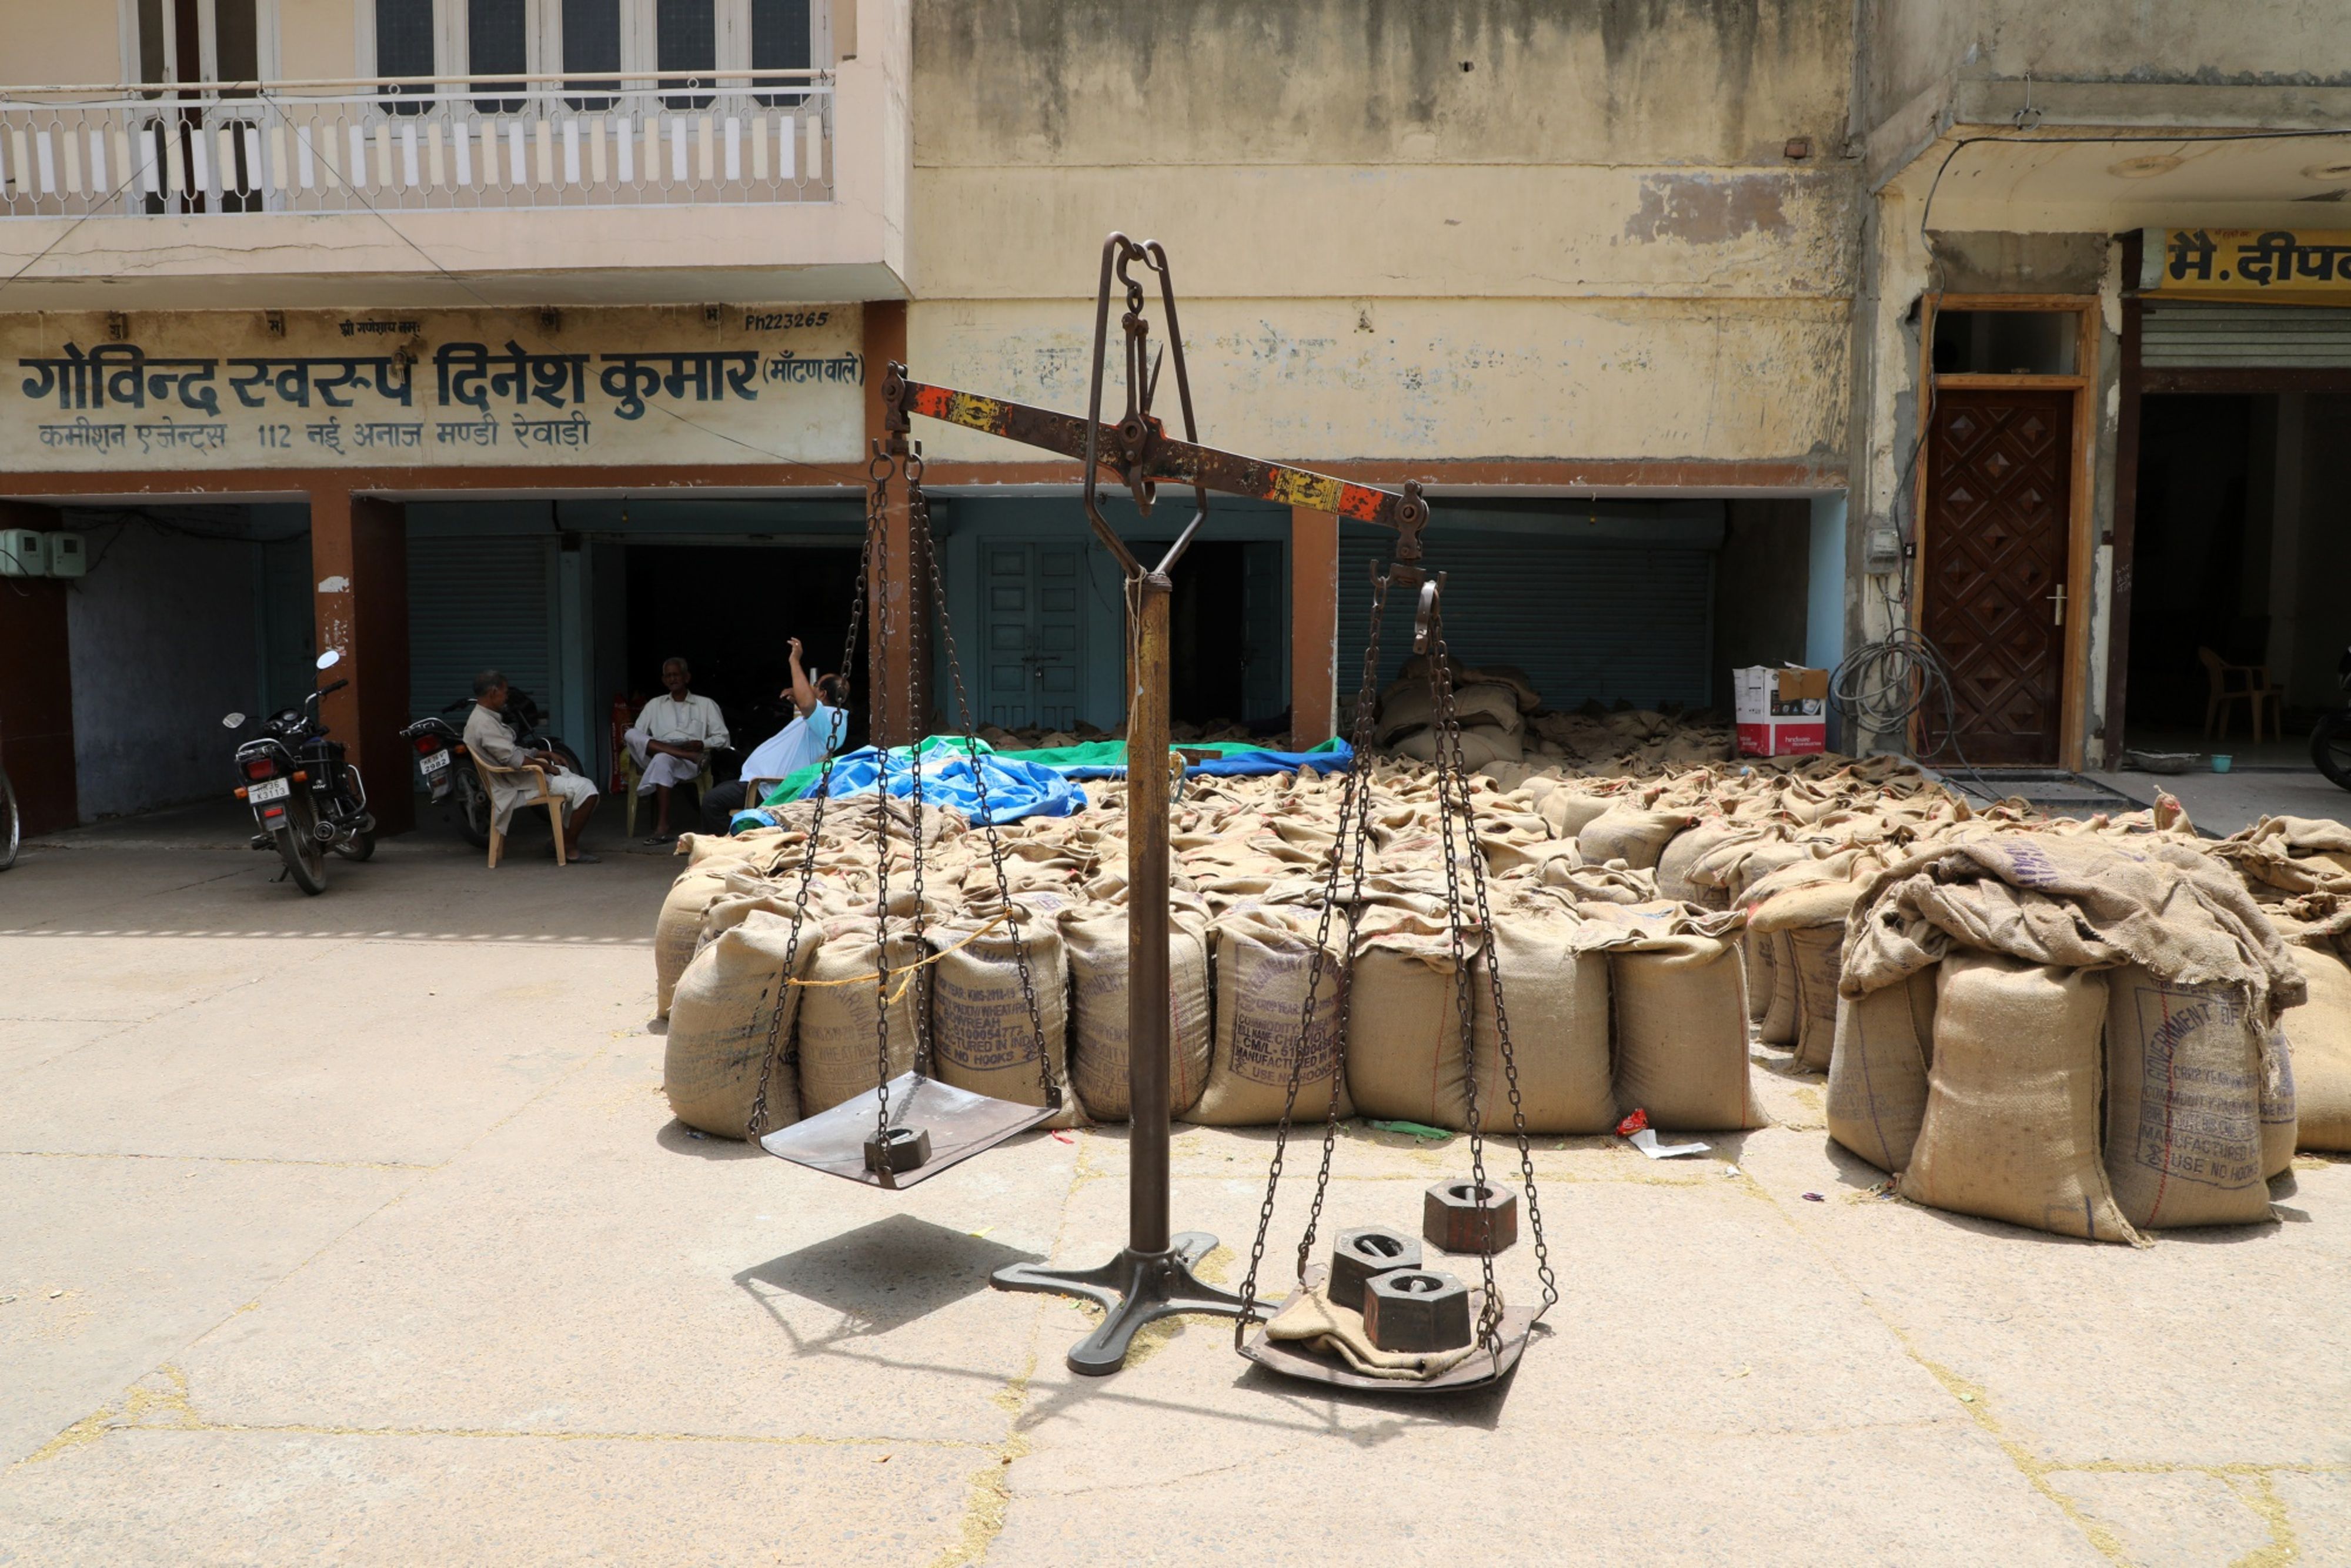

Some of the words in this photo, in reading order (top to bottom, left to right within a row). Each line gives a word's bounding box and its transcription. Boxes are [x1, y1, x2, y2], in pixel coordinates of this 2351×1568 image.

[745, 312, 830, 331] Ph223265
[18, 341, 222, 417] गोविन्द
[227, 356, 419, 408] स्वरूप
[433, 340, 590, 412] दिनेश
[600, 350, 759, 420] कुमार
[38, 416, 126, 455] कमीशन
[258, 424, 292, 449] 112
[306, 416, 346, 455] नई
[353, 422, 423, 448] अनाज
[436, 410, 499, 446] मण्डी
[512, 410, 592, 452] रेवाड़ी
[2172, 1153, 2204, 1174] USE
